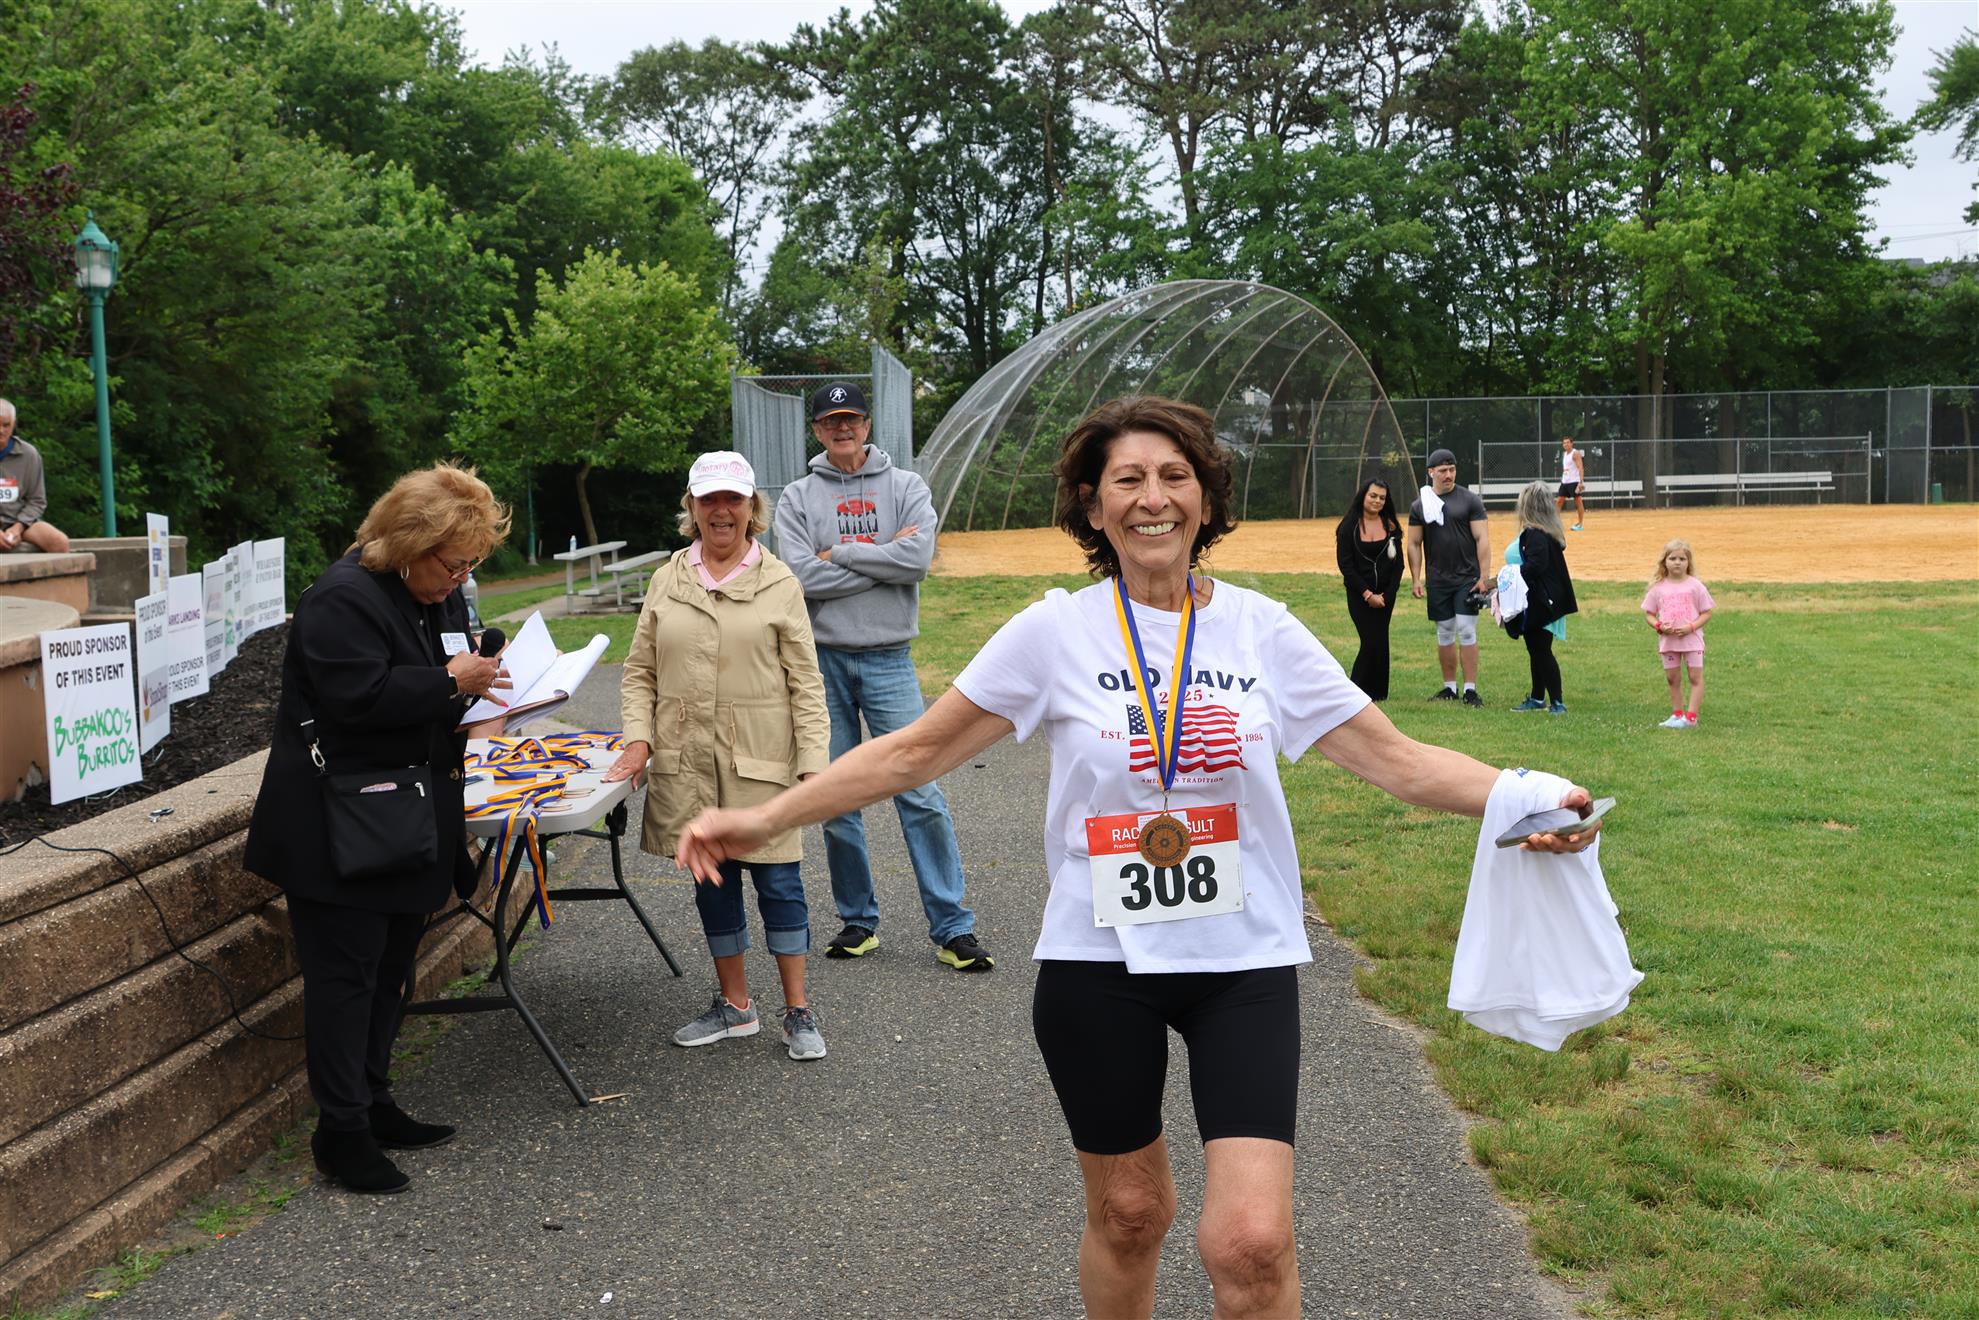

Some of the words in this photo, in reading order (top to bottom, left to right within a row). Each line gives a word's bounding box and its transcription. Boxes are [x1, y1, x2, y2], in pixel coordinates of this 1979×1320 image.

[49, 640, 83, 660] PROUD
[85, 635, 128, 655] SPONSOR
[181, 656, 204, 673] SPONSOR
[56, 672, 69, 689] OF
[72, 668, 93, 687] THIS
[95, 663, 124, 683] EVENT
[1097, 667, 1161, 692] OLD
[1159, 689, 1203, 704] 225
[1101, 730, 1126, 741] EST.
[1181, 776, 1224, 784] TRADITION
[1111, 827, 1140, 842] RAC
[1186, 818, 1215, 834] SULT
[1190, 834, 1214, 842] gineering
[1119, 855, 1219, 911] 308
